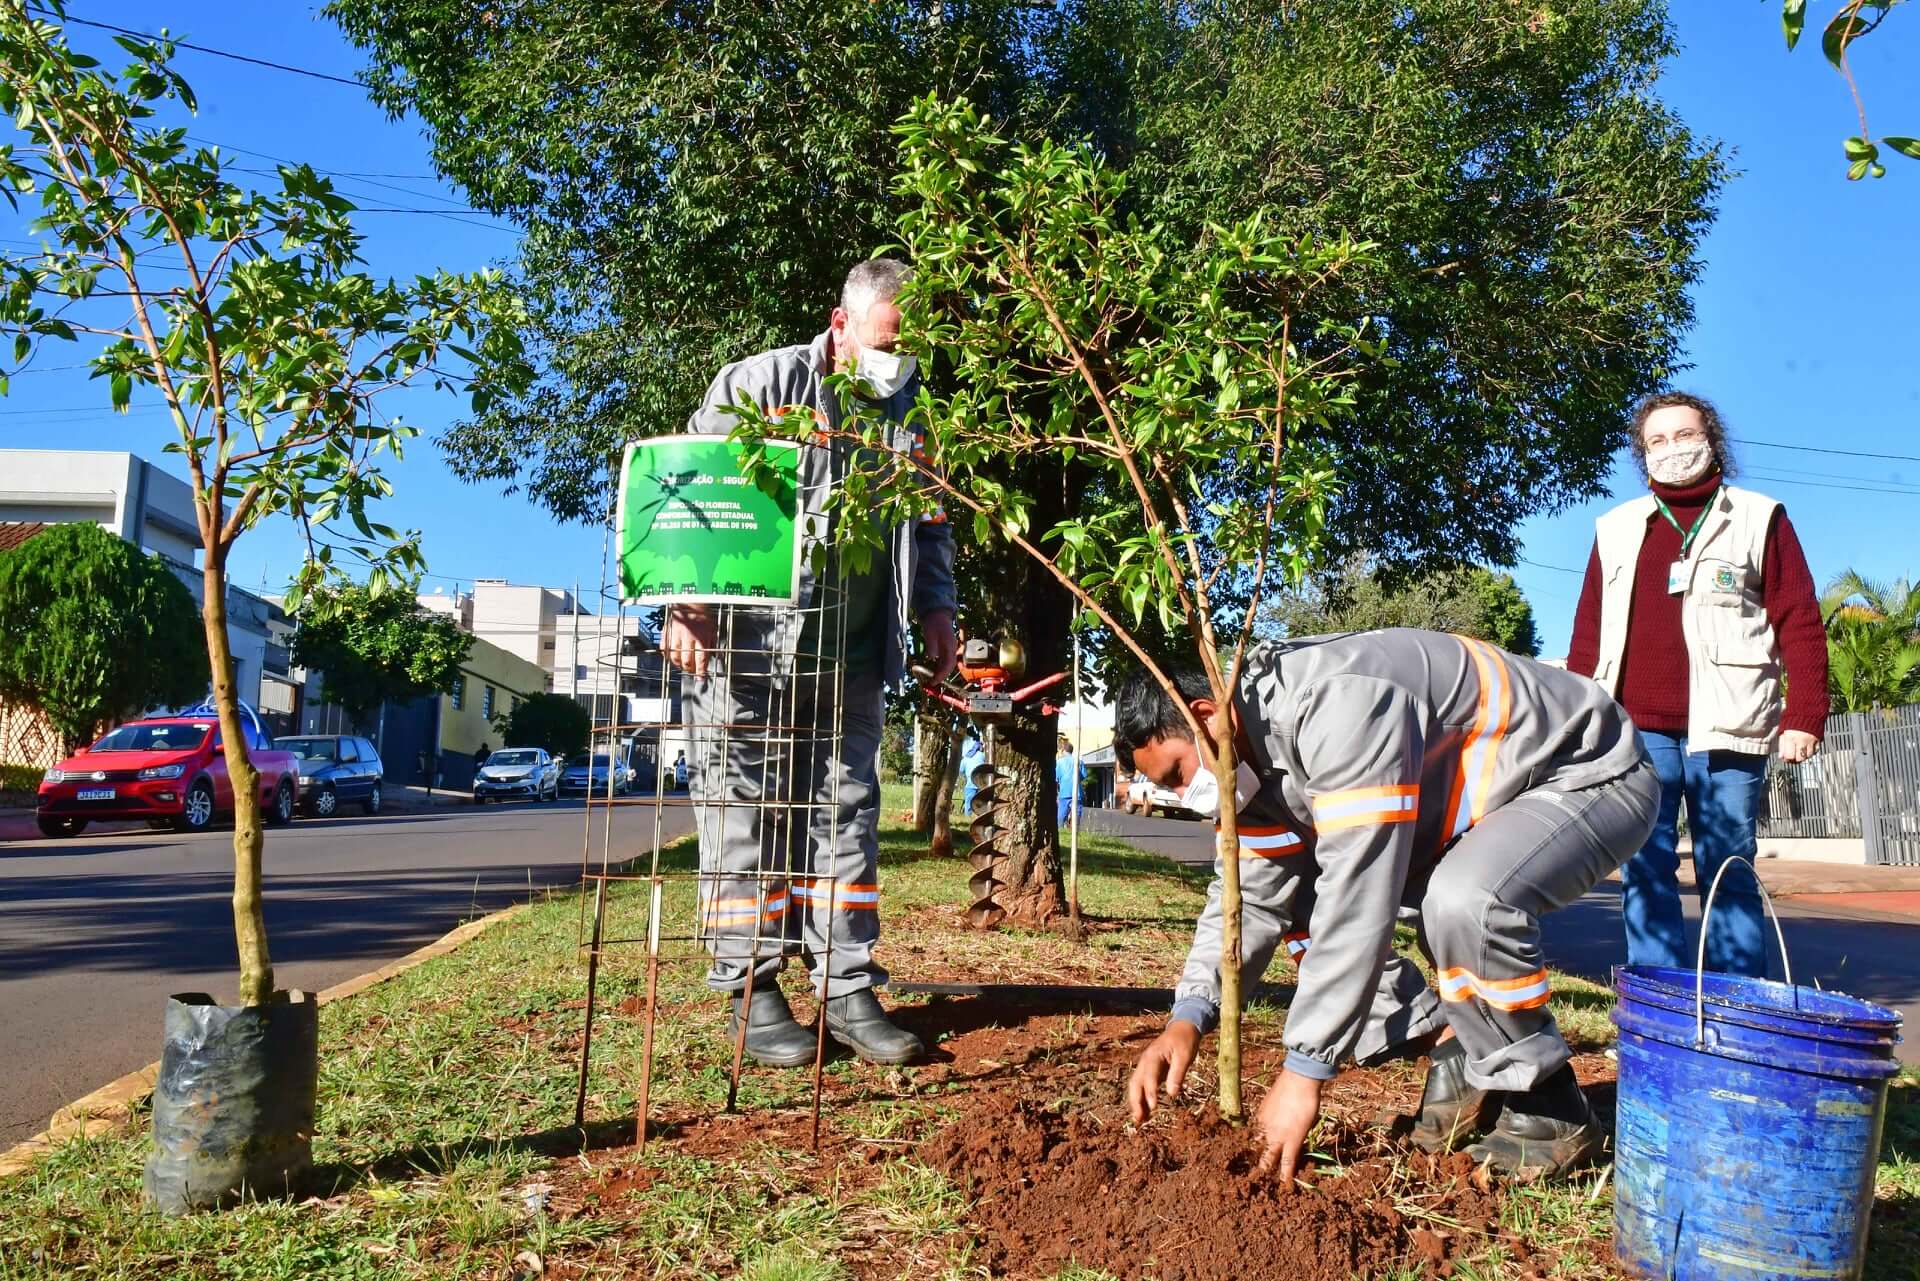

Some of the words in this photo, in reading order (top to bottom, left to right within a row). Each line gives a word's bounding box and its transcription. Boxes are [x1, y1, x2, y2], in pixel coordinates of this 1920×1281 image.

[668, 499, 705, 510] REPOSÃO
[705, 501, 741, 510] FLORESTAL
[721, 511, 755, 520] ESTADUAL
[710, 521, 730, 529] ABRIL
[731, 521, 740, 529] DE
